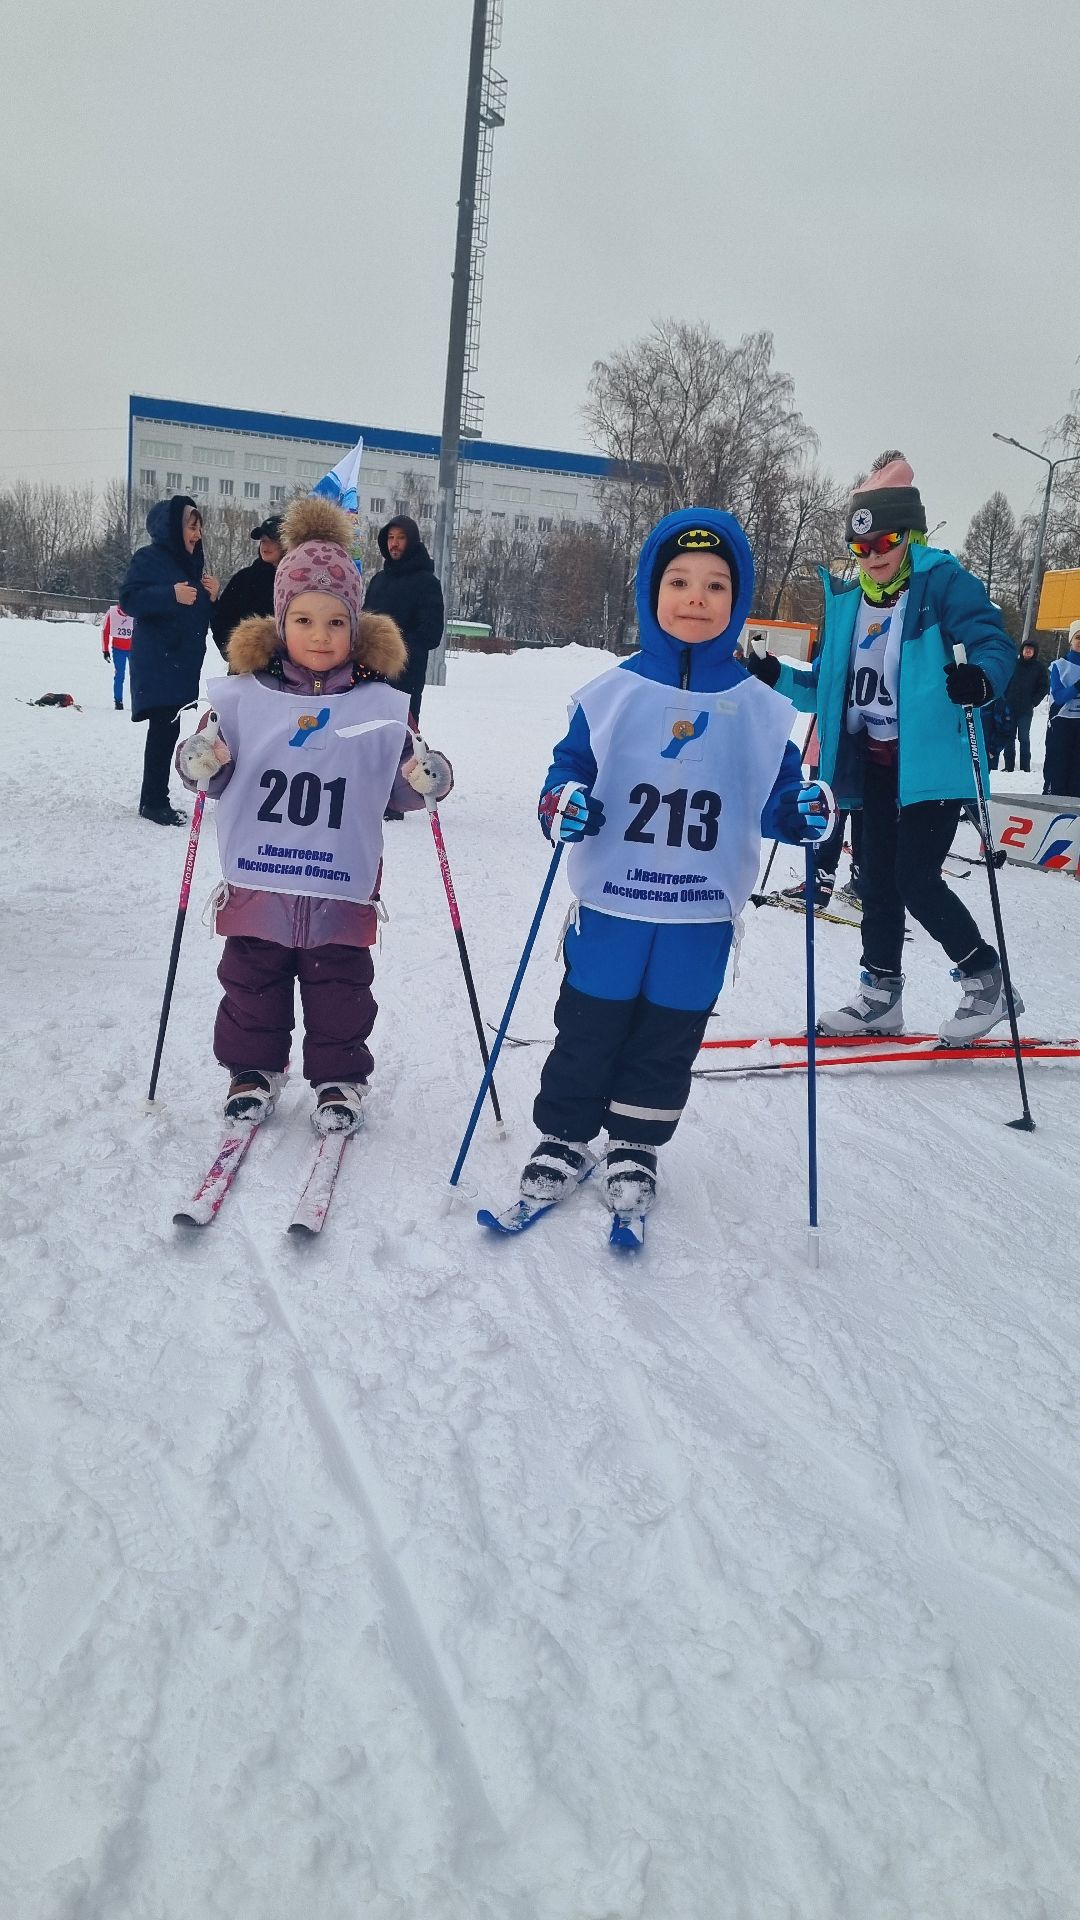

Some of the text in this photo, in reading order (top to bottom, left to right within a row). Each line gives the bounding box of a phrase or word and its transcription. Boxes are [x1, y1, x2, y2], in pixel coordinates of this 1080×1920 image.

[117, 627, 131, 636] 239
[968, 722, 980, 761] NORDWAY
[257, 769, 347, 829] 201
[624, 783, 722, 851] 213
[1000, 816, 1033, 848] 2
[184, 842, 197, 885] NORDWAY
[257, 844, 333, 863] г.Ивантеевка
[237, 858, 351, 882] Московская Область
[602, 881, 725, 903] Московская Область
